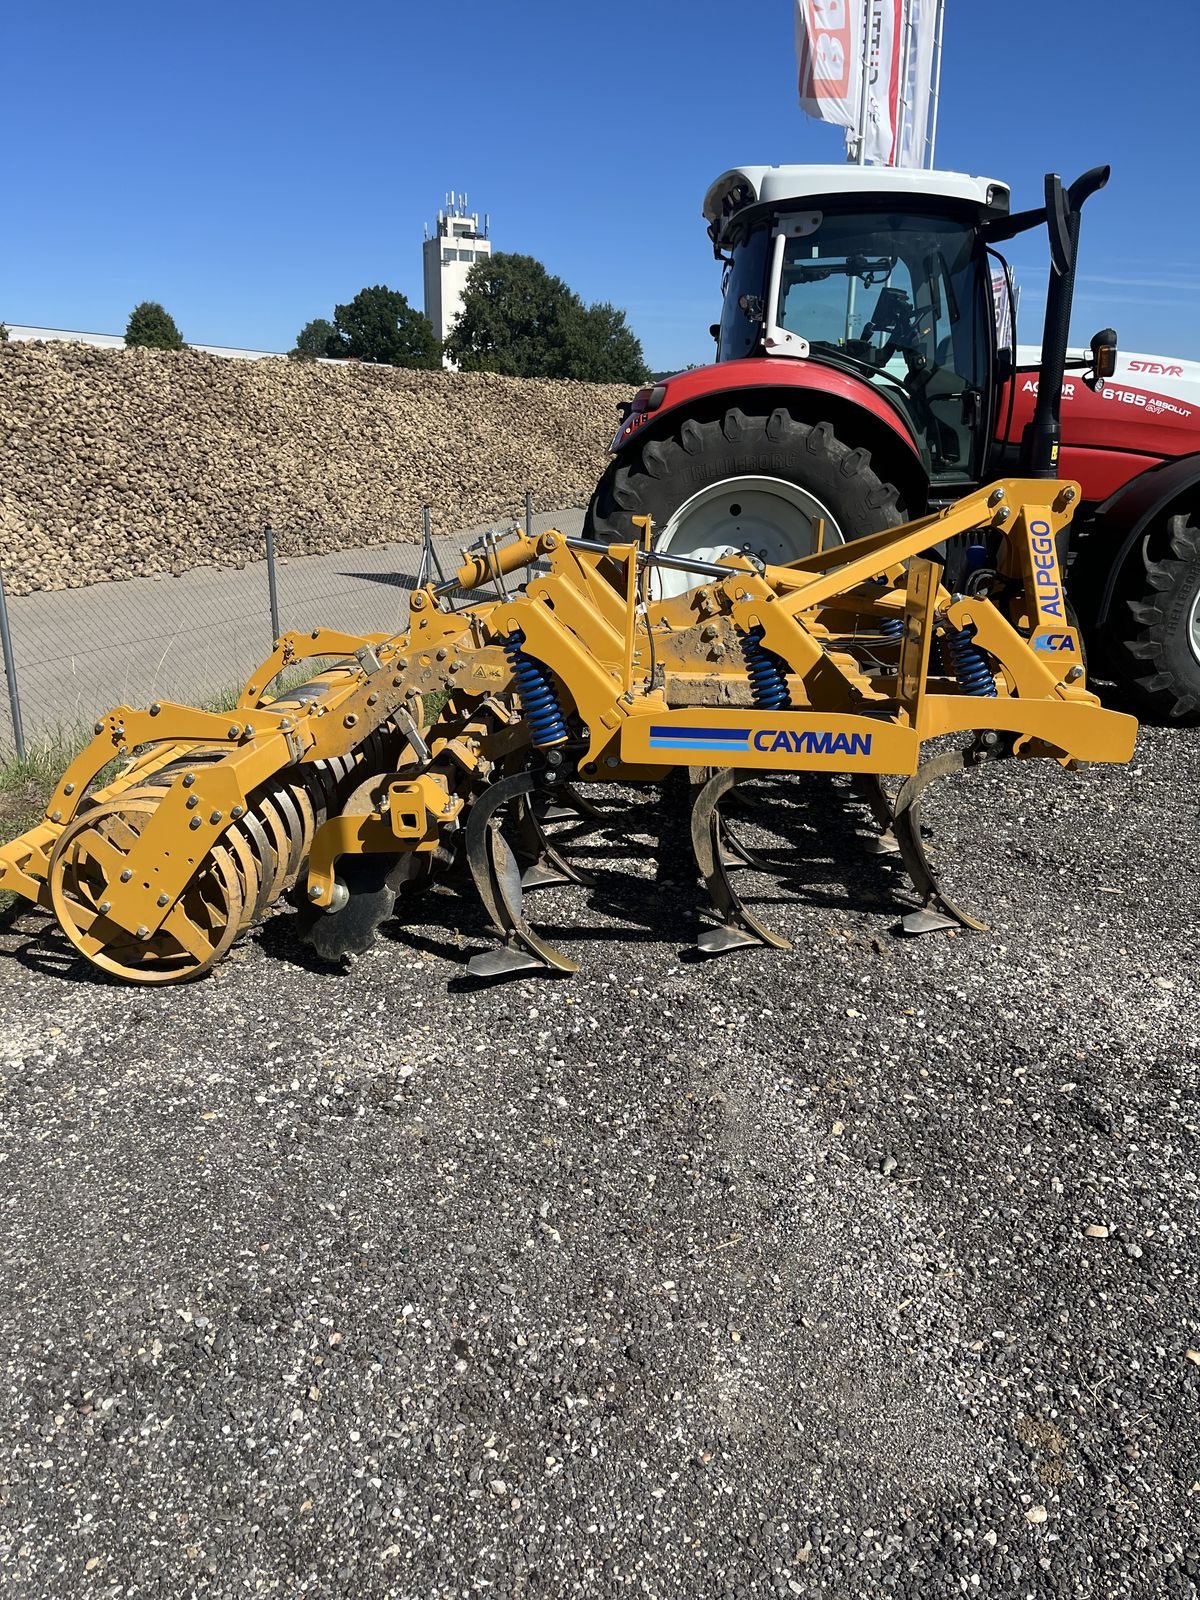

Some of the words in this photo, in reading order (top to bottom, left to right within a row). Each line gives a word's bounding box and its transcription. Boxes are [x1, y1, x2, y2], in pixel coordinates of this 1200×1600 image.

[1127, 361, 1184, 377] STEYR
[1102, 388, 1147, 406] 6185
[1148, 398, 1192, 417] ABSOLUT
[1030, 520, 1062, 617] ALPEGO
[753, 730, 872, 755] CAYMAN
